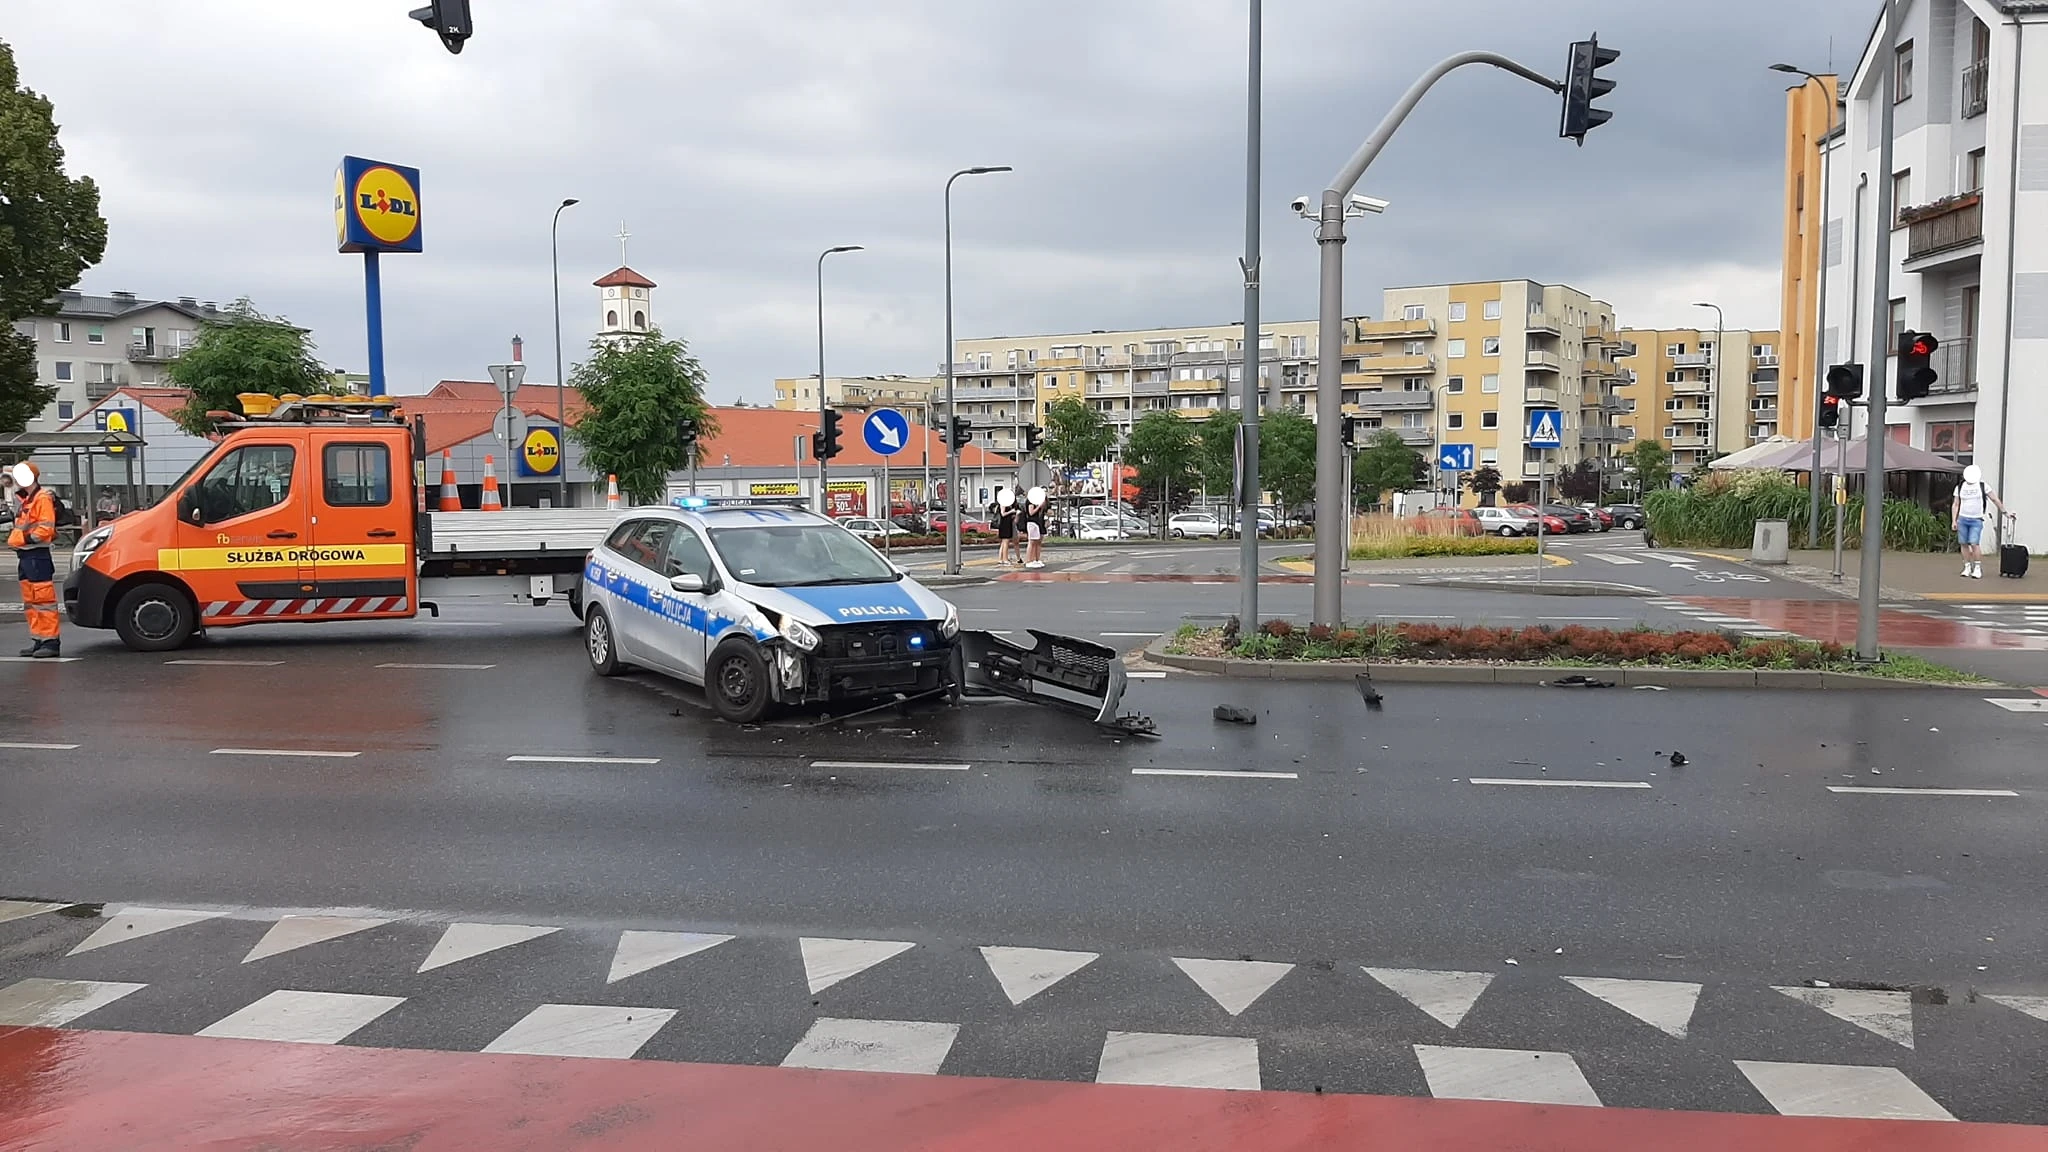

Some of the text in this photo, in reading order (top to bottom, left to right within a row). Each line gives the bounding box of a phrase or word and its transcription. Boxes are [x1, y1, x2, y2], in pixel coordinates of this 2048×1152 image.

[227, 549, 365, 563] SŁUŻBA DROGOWA
[661, 597, 692, 624] POLICJA
[838, 606, 911, 617] POLICJA
